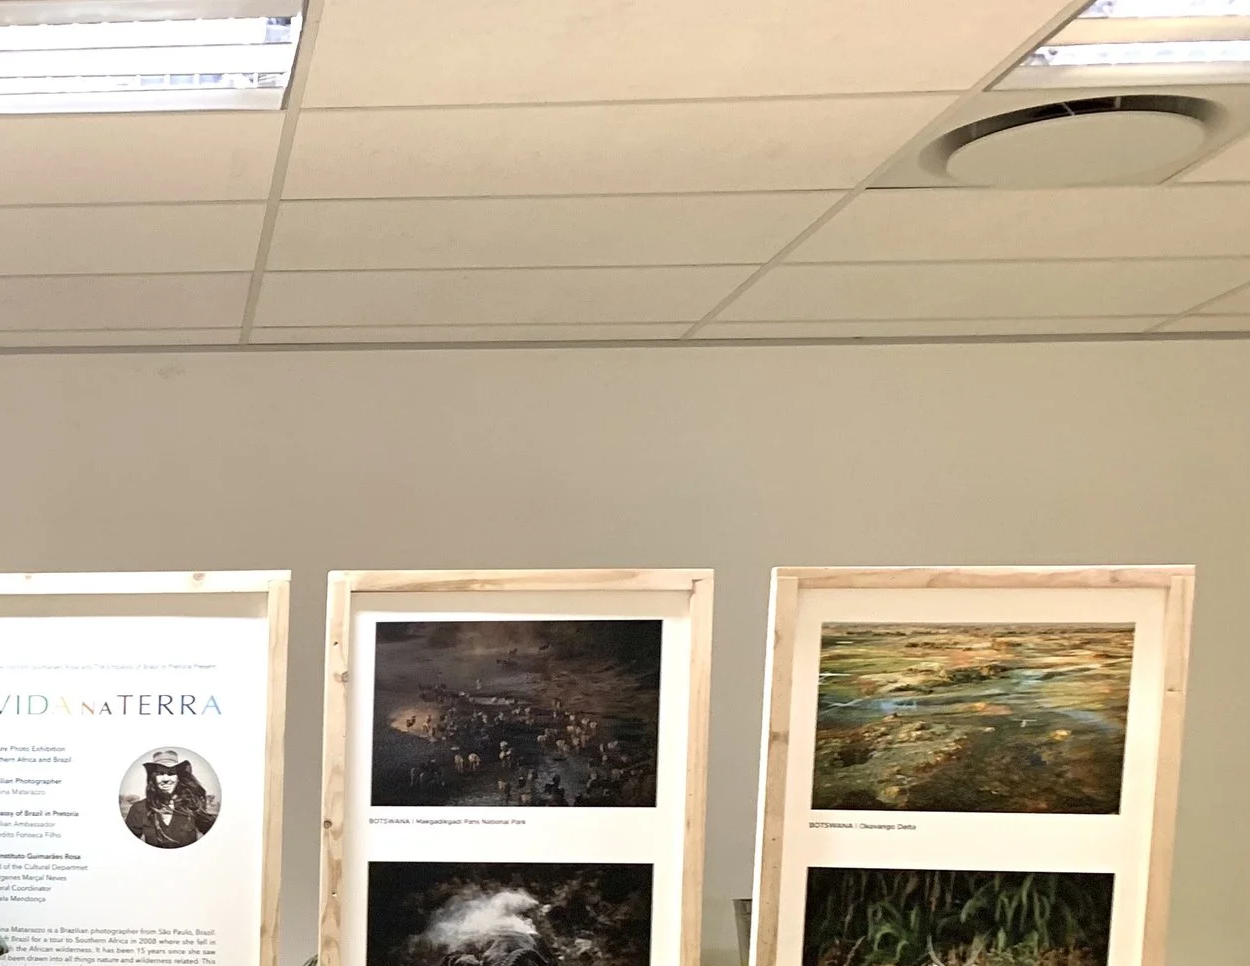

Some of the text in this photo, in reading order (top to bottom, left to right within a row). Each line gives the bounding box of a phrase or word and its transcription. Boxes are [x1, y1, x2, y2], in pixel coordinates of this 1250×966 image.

[117, 694, 222, 715] TERRA
[52, 755, 72, 763] Brazil
[14, 777, 62, 785] Photographer
[808, 821, 917, 830] BOTSWANA Okavango Delta
